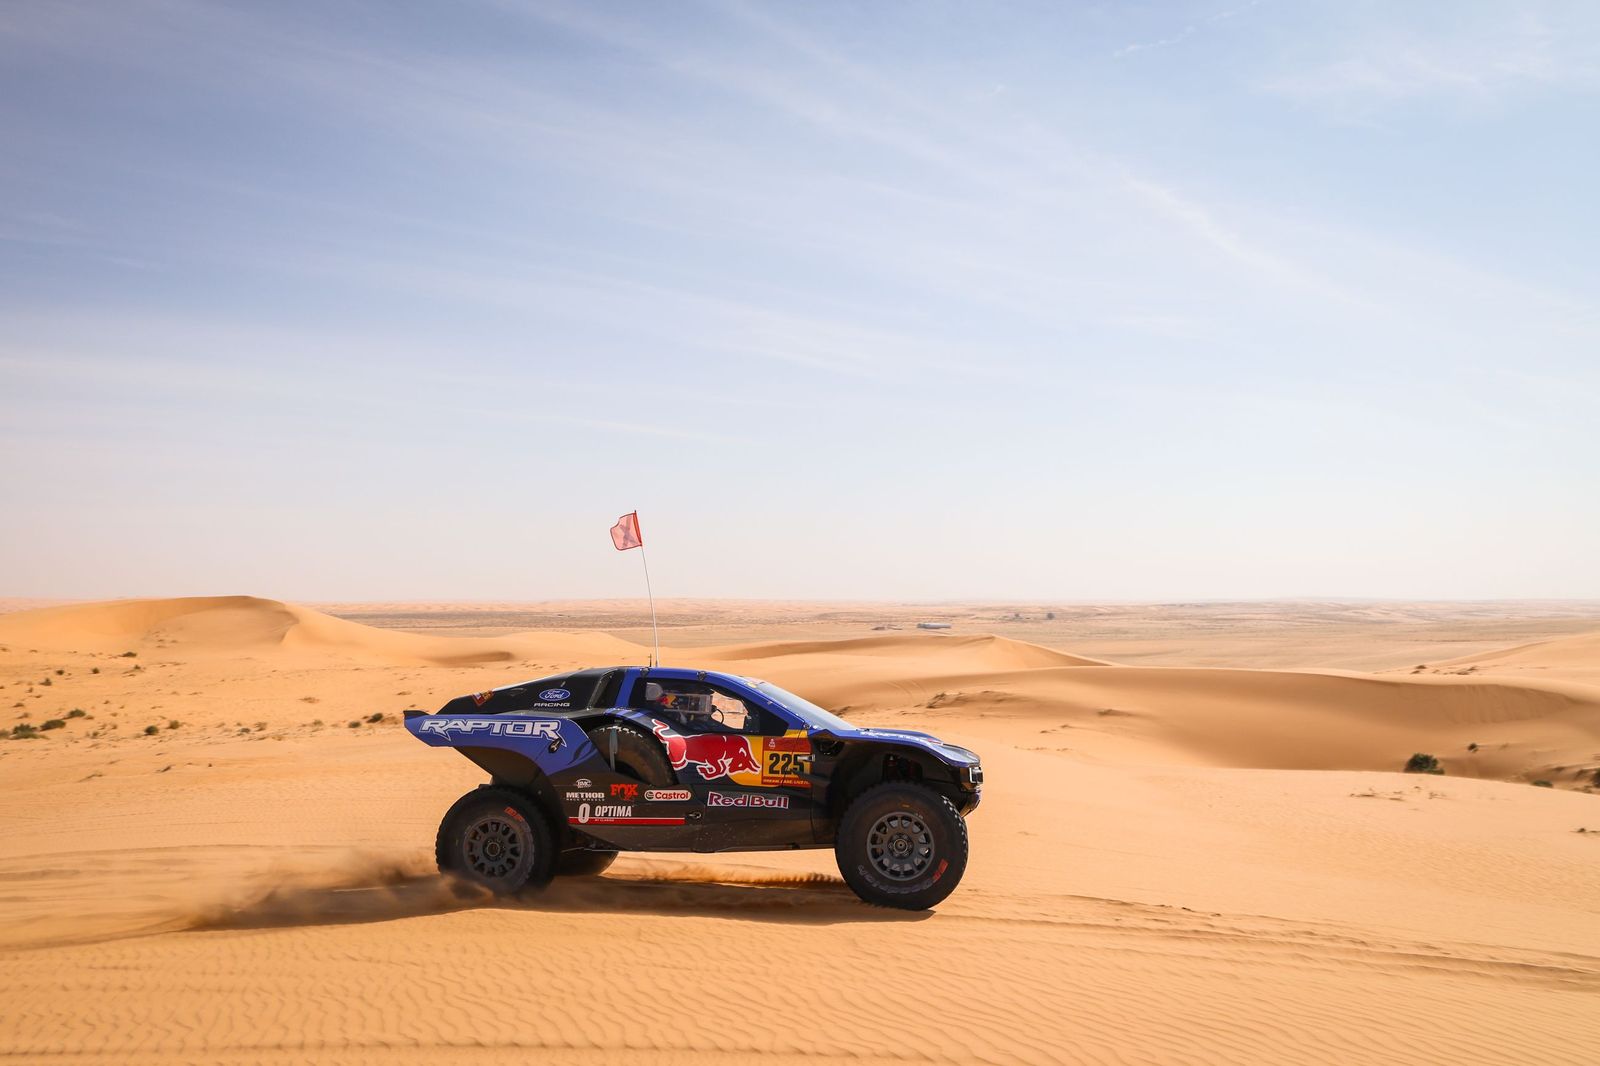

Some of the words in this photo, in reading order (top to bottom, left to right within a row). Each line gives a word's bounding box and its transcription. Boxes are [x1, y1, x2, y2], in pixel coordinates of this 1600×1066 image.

[545, 690, 565, 699] Ford
[419, 719, 567, 747] RAPTOR
[769, 753, 805, 775] 225
[611, 784, 638, 800] FOX
[655, 792, 689, 800] Castrol
[708, 792, 748, 807] Red
[749, 795, 789, 808] Bull
[595, 805, 632, 817] OPTIMA
